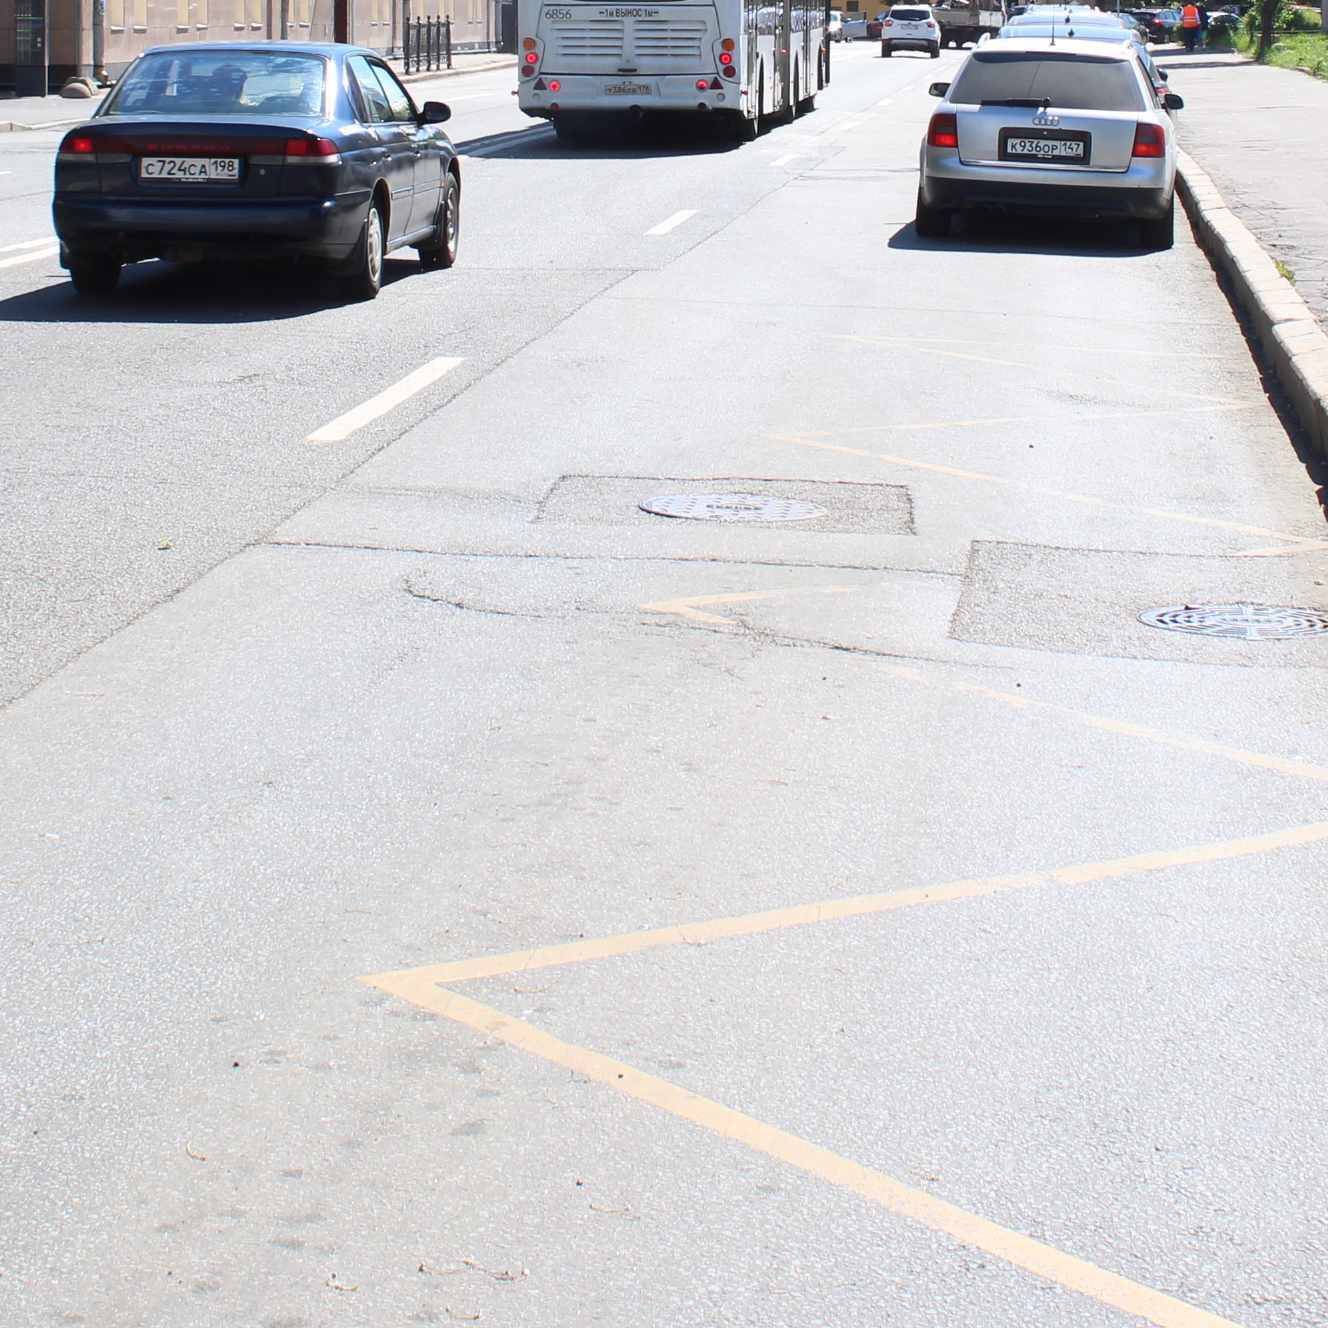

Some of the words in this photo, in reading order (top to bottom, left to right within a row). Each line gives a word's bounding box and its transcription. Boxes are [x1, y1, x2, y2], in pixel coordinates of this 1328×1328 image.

[545, 8, 572, 20] 6856
[1062, 142, 1081, 152] 147
[212, 159, 235, 172] 198
